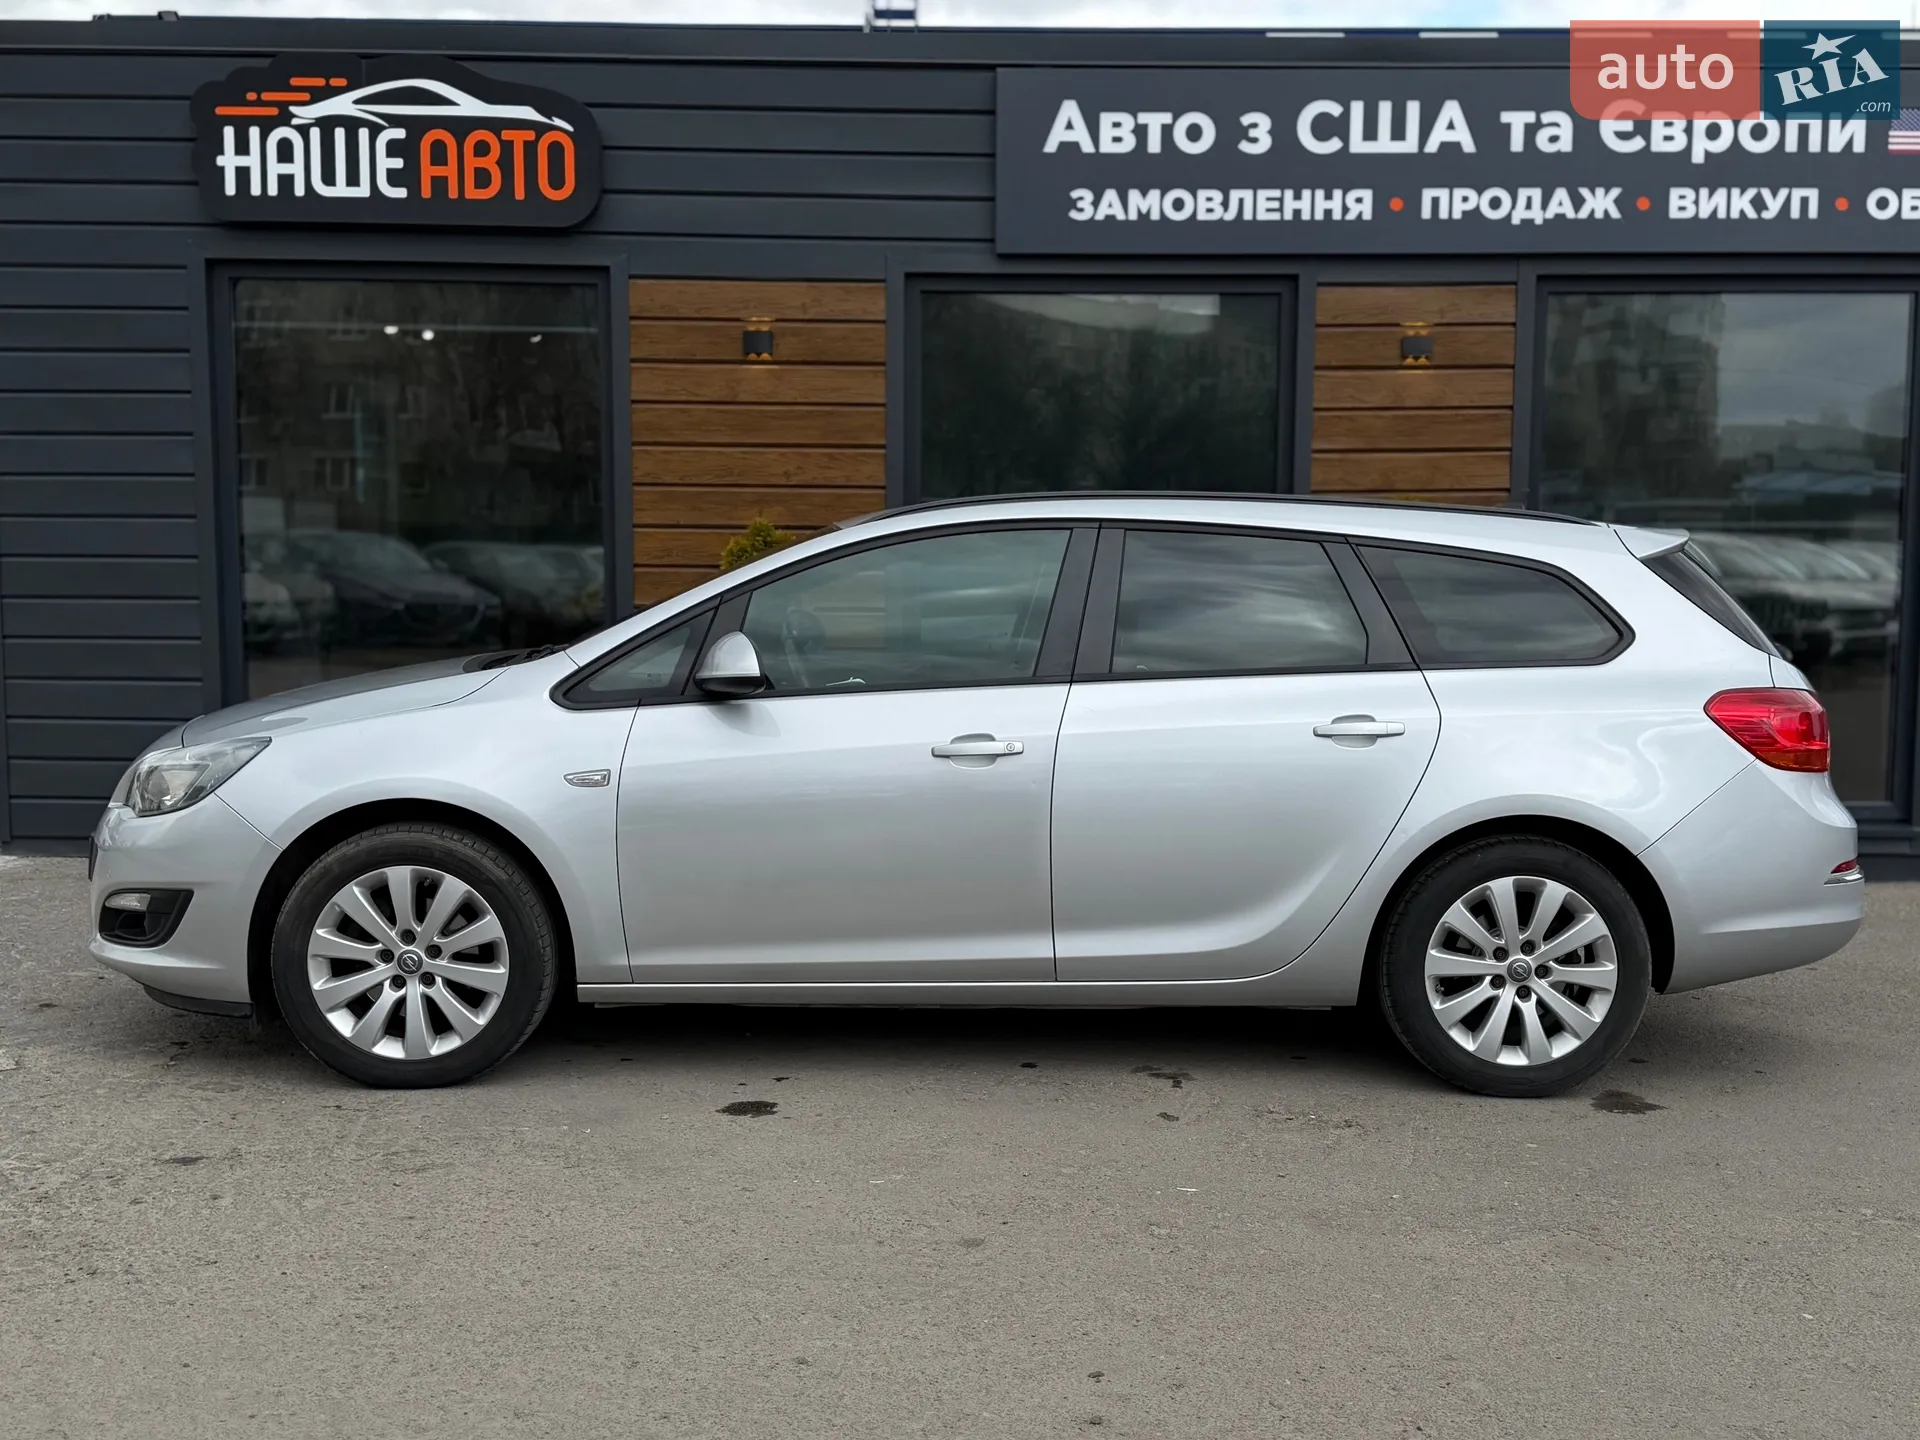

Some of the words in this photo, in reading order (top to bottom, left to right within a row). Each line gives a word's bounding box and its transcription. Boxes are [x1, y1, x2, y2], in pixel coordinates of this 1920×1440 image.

[216, 126, 408, 198] НАШЕ
[420, 129, 575, 201] АВТО
[1042, 99, 1216, 155] Авто
[1236, 111, 1272, 155] з
[1296, 99, 1477, 155] США
[1500, 110, 1574, 153] та
[1598, 98, 1867, 164] Європи
[1068, 187, 1373, 221] ЗАМОВЛЕННЯ
[1420, 186, 1623, 225] ПРОДАЖ
[1668, 187, 1819, 220] ВИКУП
